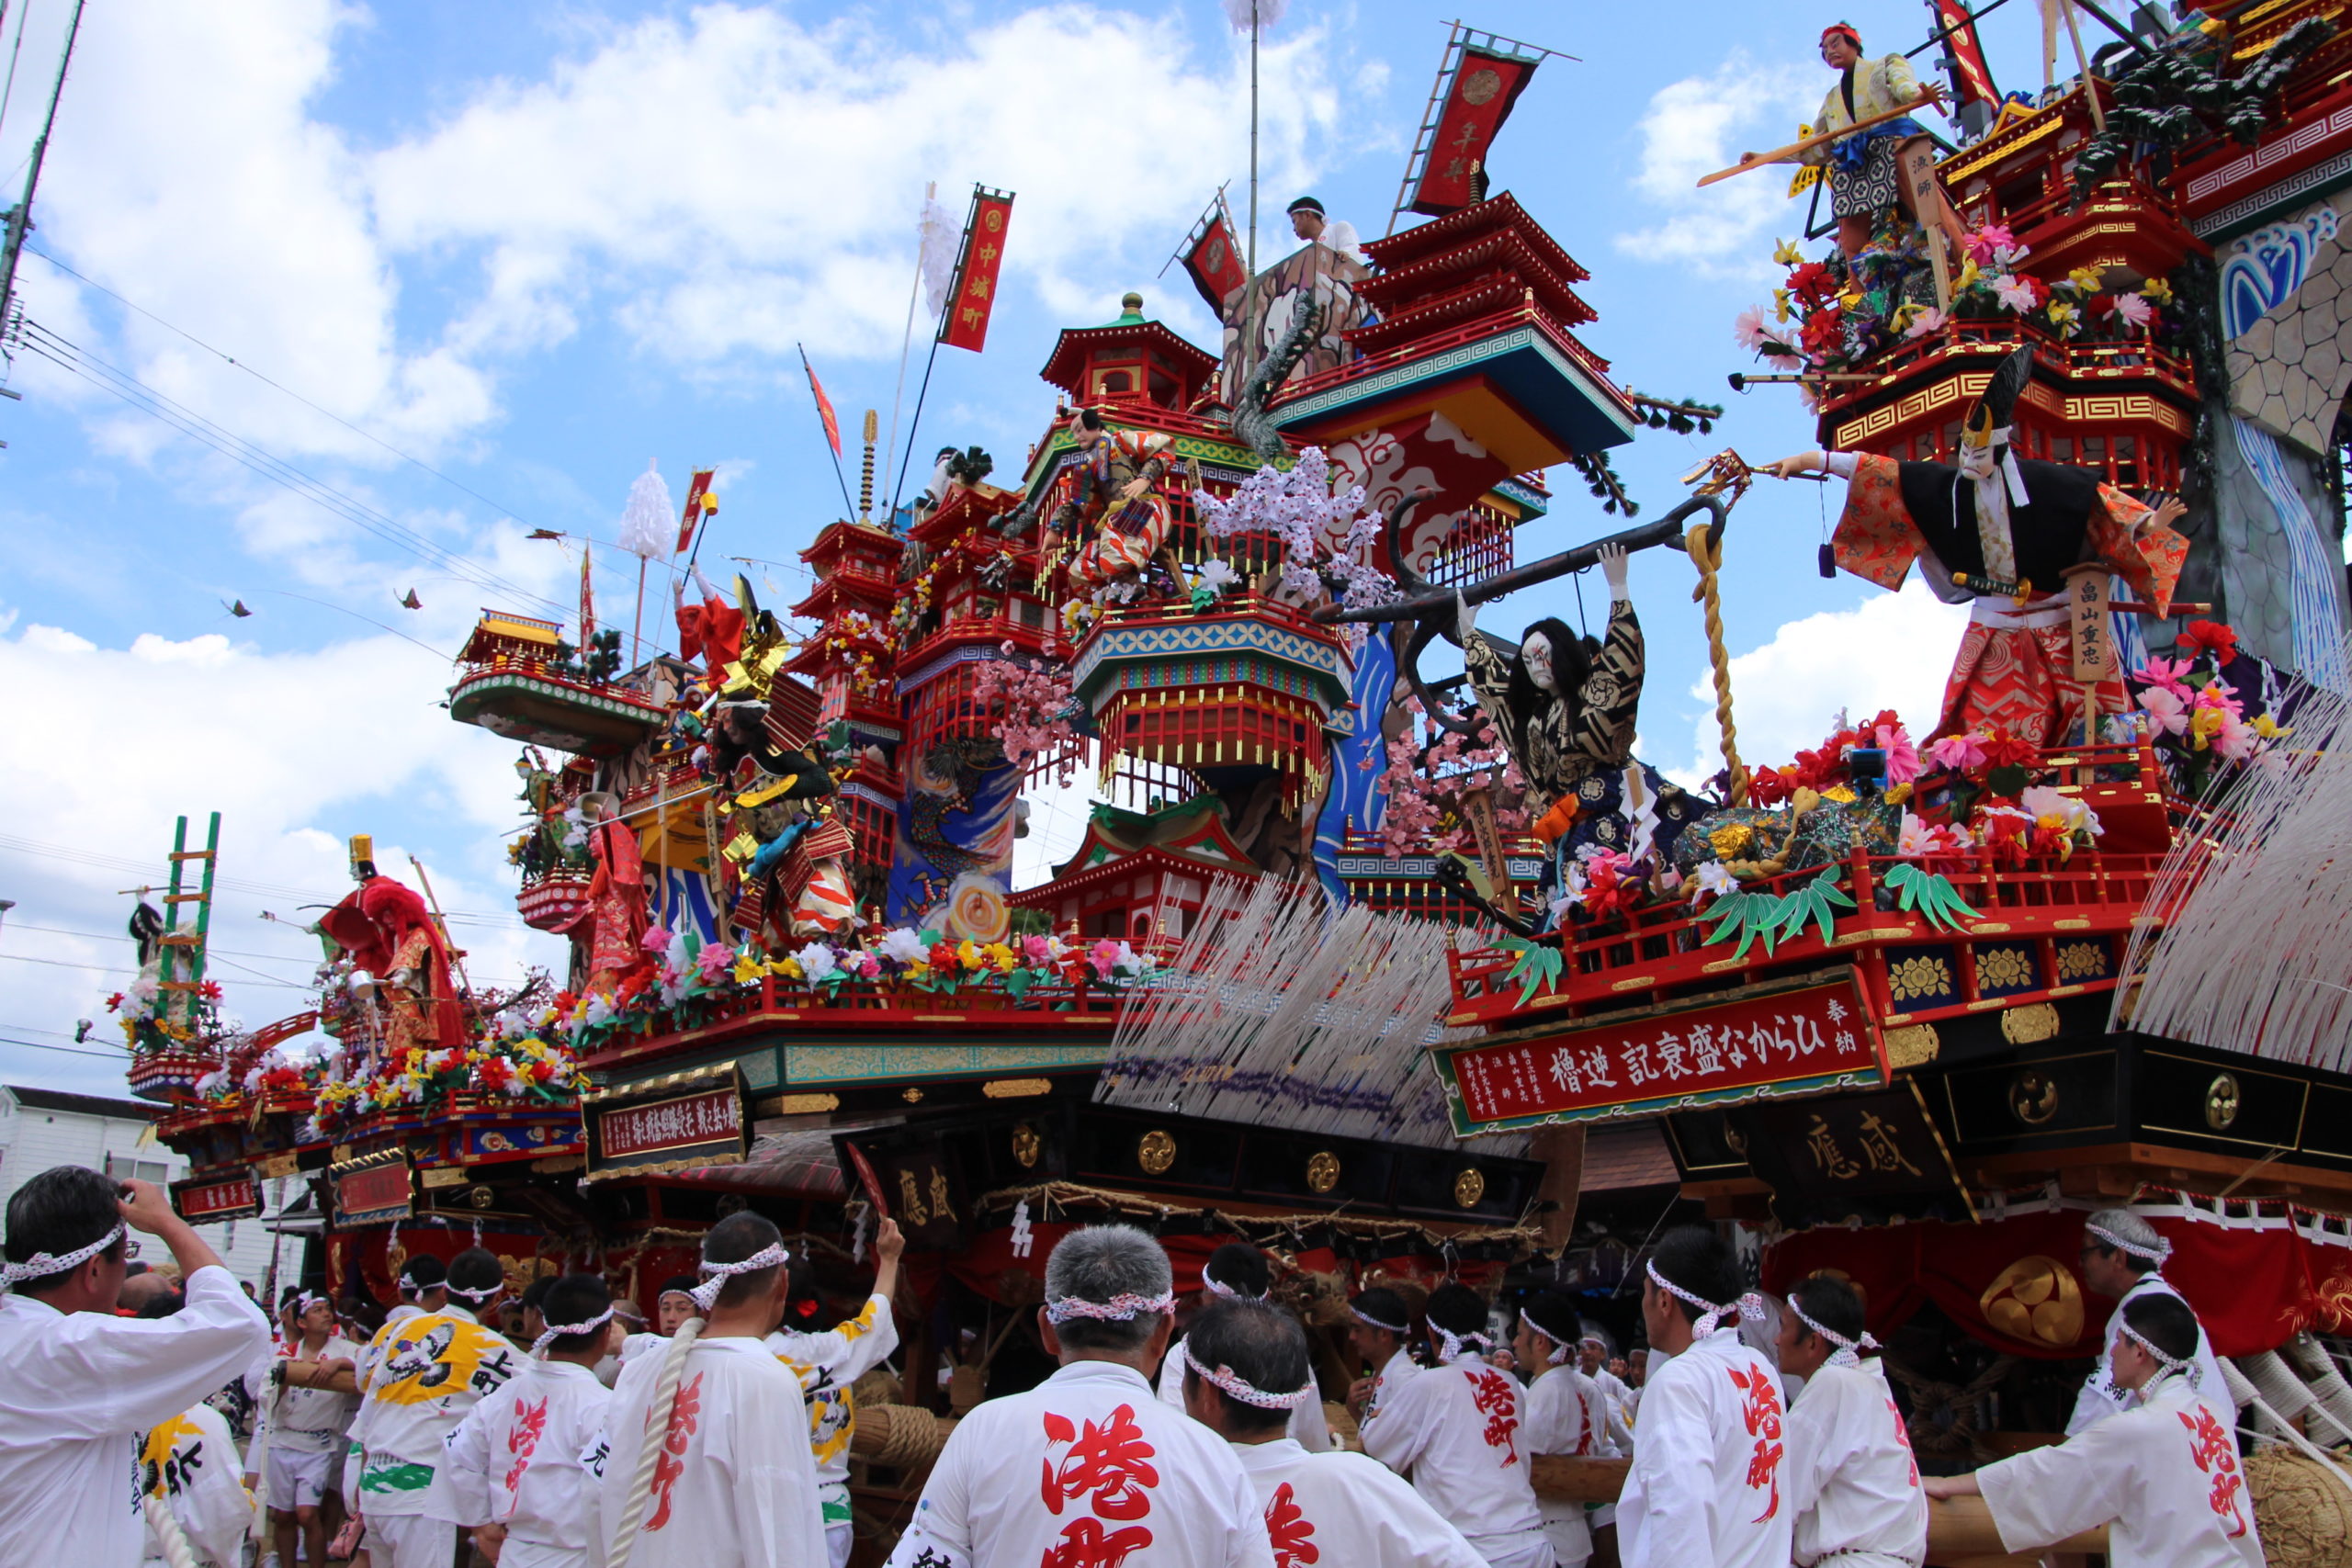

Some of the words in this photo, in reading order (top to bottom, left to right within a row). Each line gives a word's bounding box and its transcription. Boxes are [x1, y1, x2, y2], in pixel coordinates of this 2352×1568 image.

[1912, 155, 1931, 197] 漁師
[962, 243, 998, 332] 中城町
[2078, 581, 2100, 666] 畠山重忠
[1620, 1014, 1826, 1087] ひらかな盛衰記
[1826, 998, 1857, 1055] 奉納
[1549, 1045, 1618, 1094] 逆櫓
[471, 1349, 514, 1396] 上町
[499, 1394, 548, 1518] 港町
[1464, 1368, 1519, 1469] 港町
[1726, 1360, 1783, 1524] 港町
[583, 1441, 610, 1478] 元
[2176, 1403, 2247, 1540] 港町
